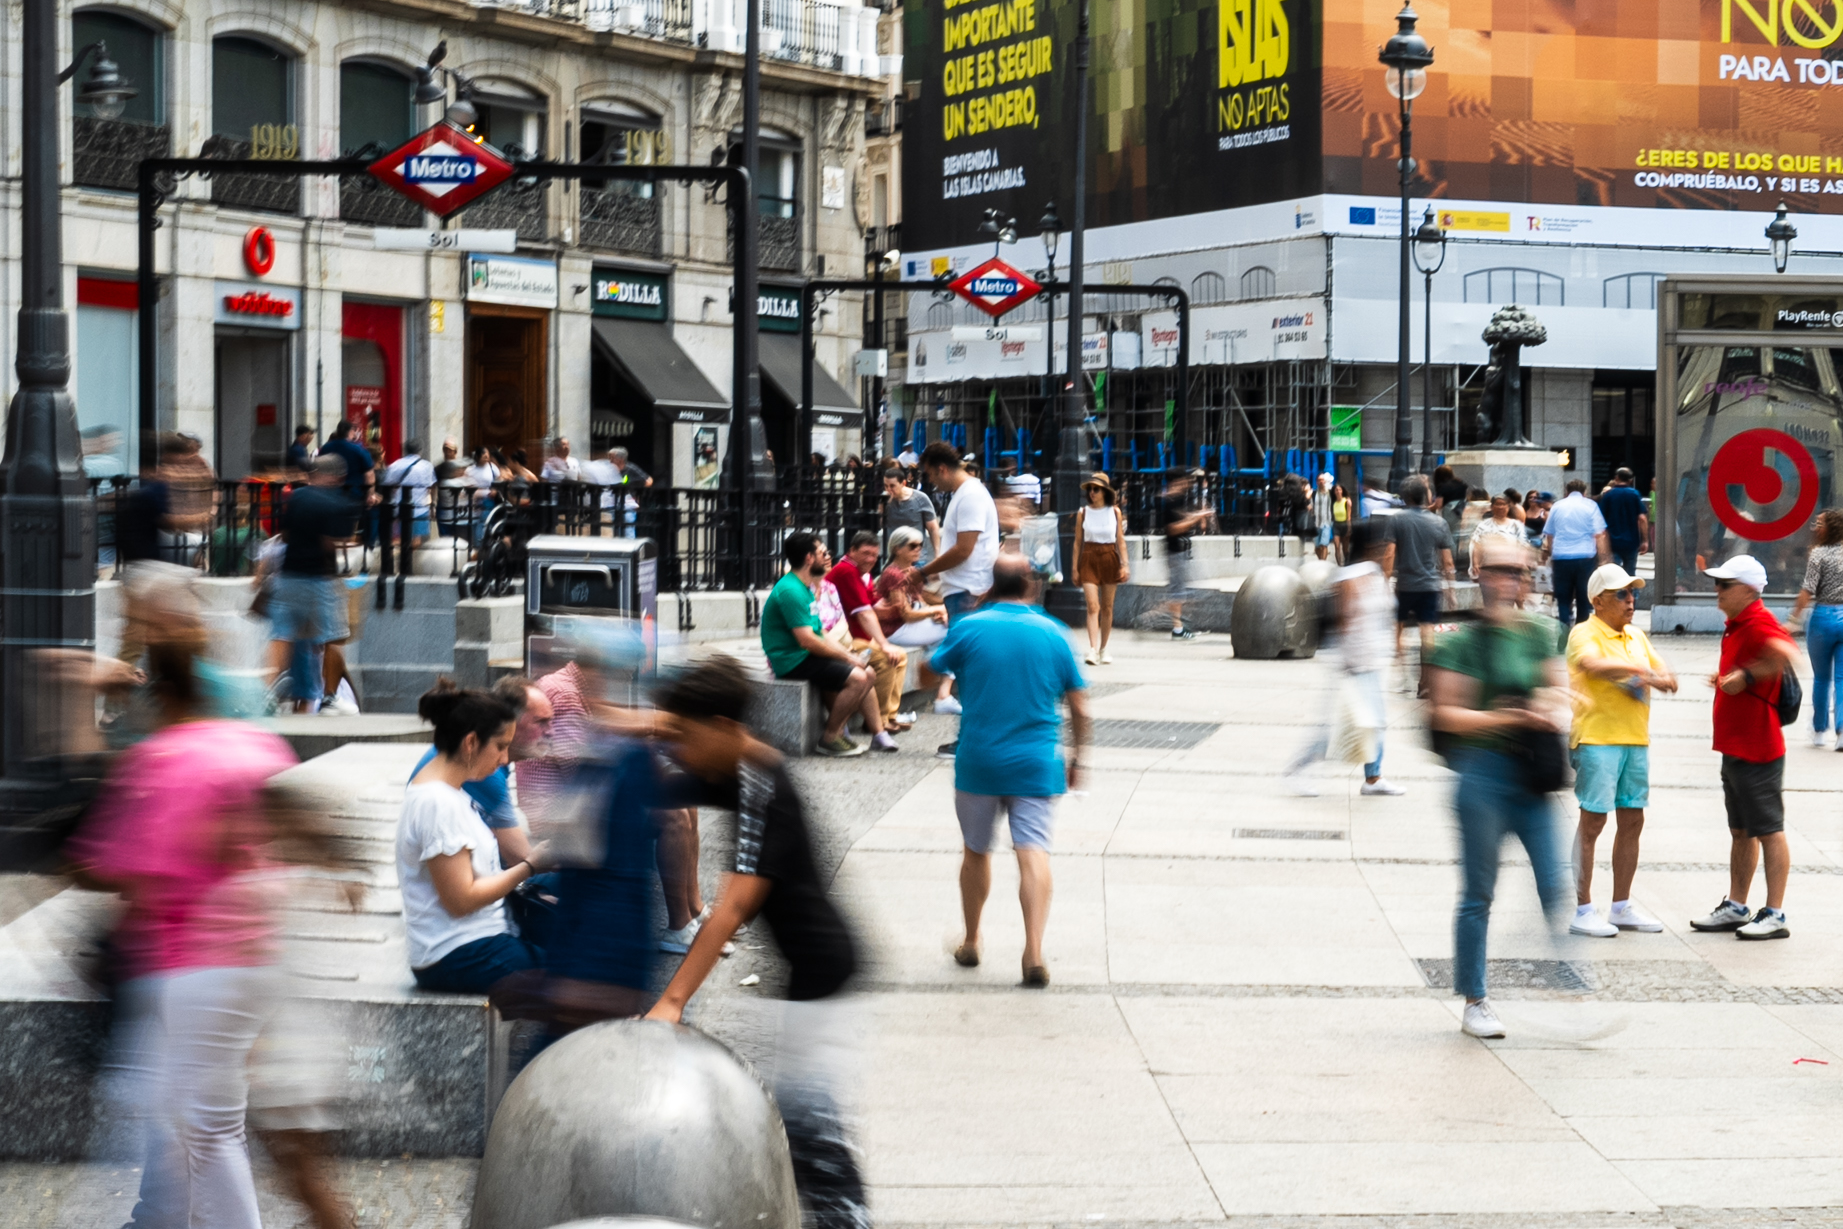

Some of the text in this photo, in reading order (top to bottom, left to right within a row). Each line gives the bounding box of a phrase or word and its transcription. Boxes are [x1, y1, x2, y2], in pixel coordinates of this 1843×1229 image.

[944, 35, 1052, 97] QUE ES SEGUIR
[1719, 54, 1791, 82] PARA
[943, 85, 1040, 141] UN SENDERO,
[1218, 82, 1289, 132] NO APTAS
[250, 123, 298, 160] 1919
[625, 129, 672, 165] 1919
[1219, 124, 1291, 151] PARA TODOS LOS PÚBLICOS
[410, 157, 472, 179] Metro
[943, 147, 999, 177] BIENVENIDO A
[1635, 148, 1698, 168] ¿ERES
[1703, 151, 1730, 169] DE
[1735, 152, 1773, 172] LOS
[1778, 154, 1821, 173] QUE
[943, 166, 1026, 199] LAS ISLAS CANARIAS.
[1634, 170, 1763, 194] COMPRUÉBALO,
[1765, 176, 1777, 191] Y
[1780, 177, 1796, 192] SI
[1800, 178, 1820, 193] ES
[428, 232, 458, 248] Sol
[975, 279, 1014, 293] Metro
[757, 296, 799, 318] DILLA
[1778, 310, 1831, 323] PlayRenfe
[985, 328, 1008, 341] Sol
[1704, 377, 1768, 401] renfe
